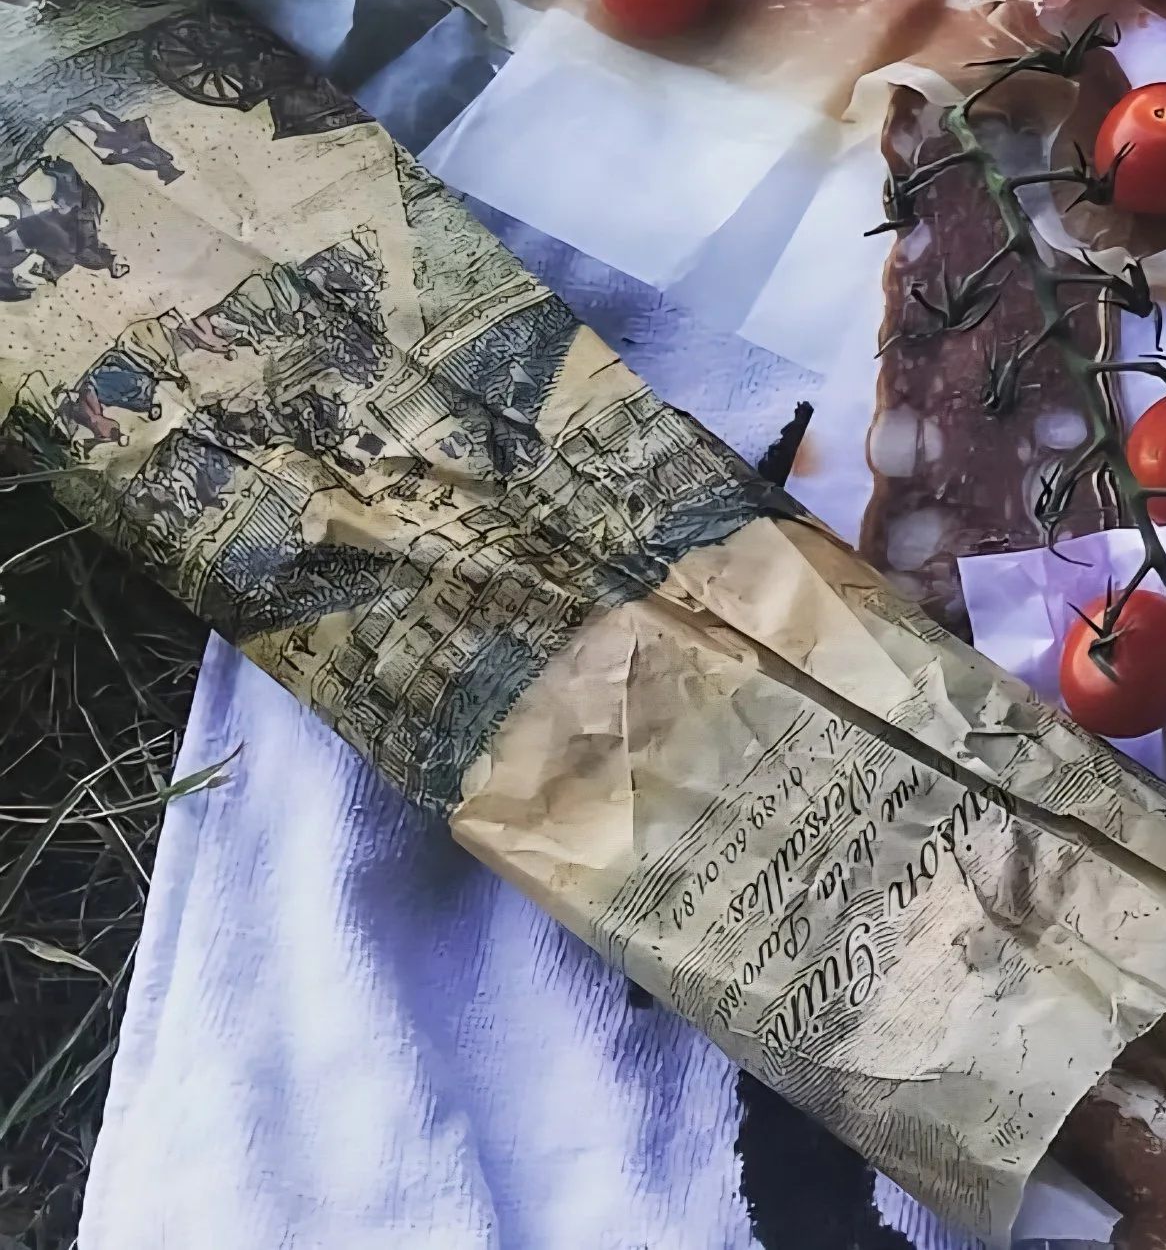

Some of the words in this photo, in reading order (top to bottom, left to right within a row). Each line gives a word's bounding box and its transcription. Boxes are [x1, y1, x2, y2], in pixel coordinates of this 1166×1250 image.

[881, 765, 920, 822] rue
[728, 756, 877, 923] Versailles
[846, 820, 877, 868] de
[817, 861, 849, 902] la
